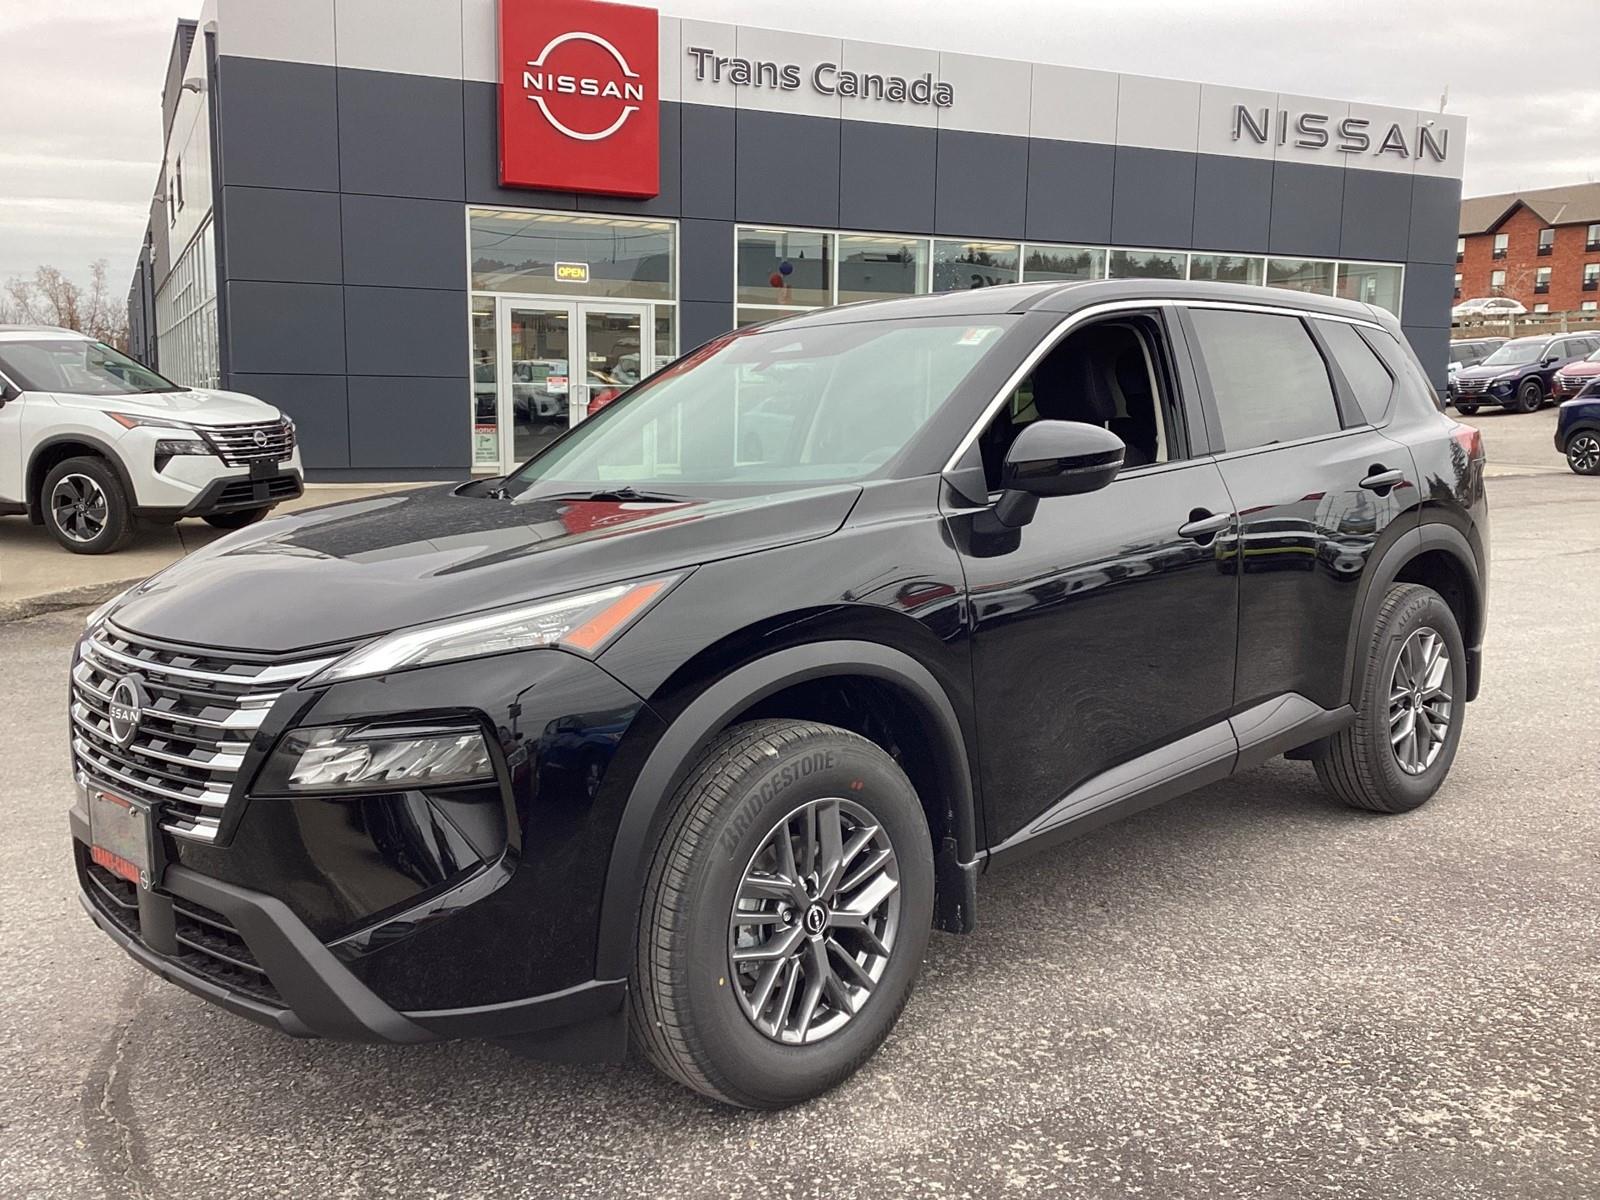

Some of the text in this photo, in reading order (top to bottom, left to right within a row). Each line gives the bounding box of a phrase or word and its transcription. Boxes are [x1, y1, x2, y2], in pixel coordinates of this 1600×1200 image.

[523, 71, 644, 102] NISSAN
[688, 47, 956, 108] Trans Canada
[1232, 104, 1449, 162] NISSAN
[558, 266, 586, 279] OPEN
